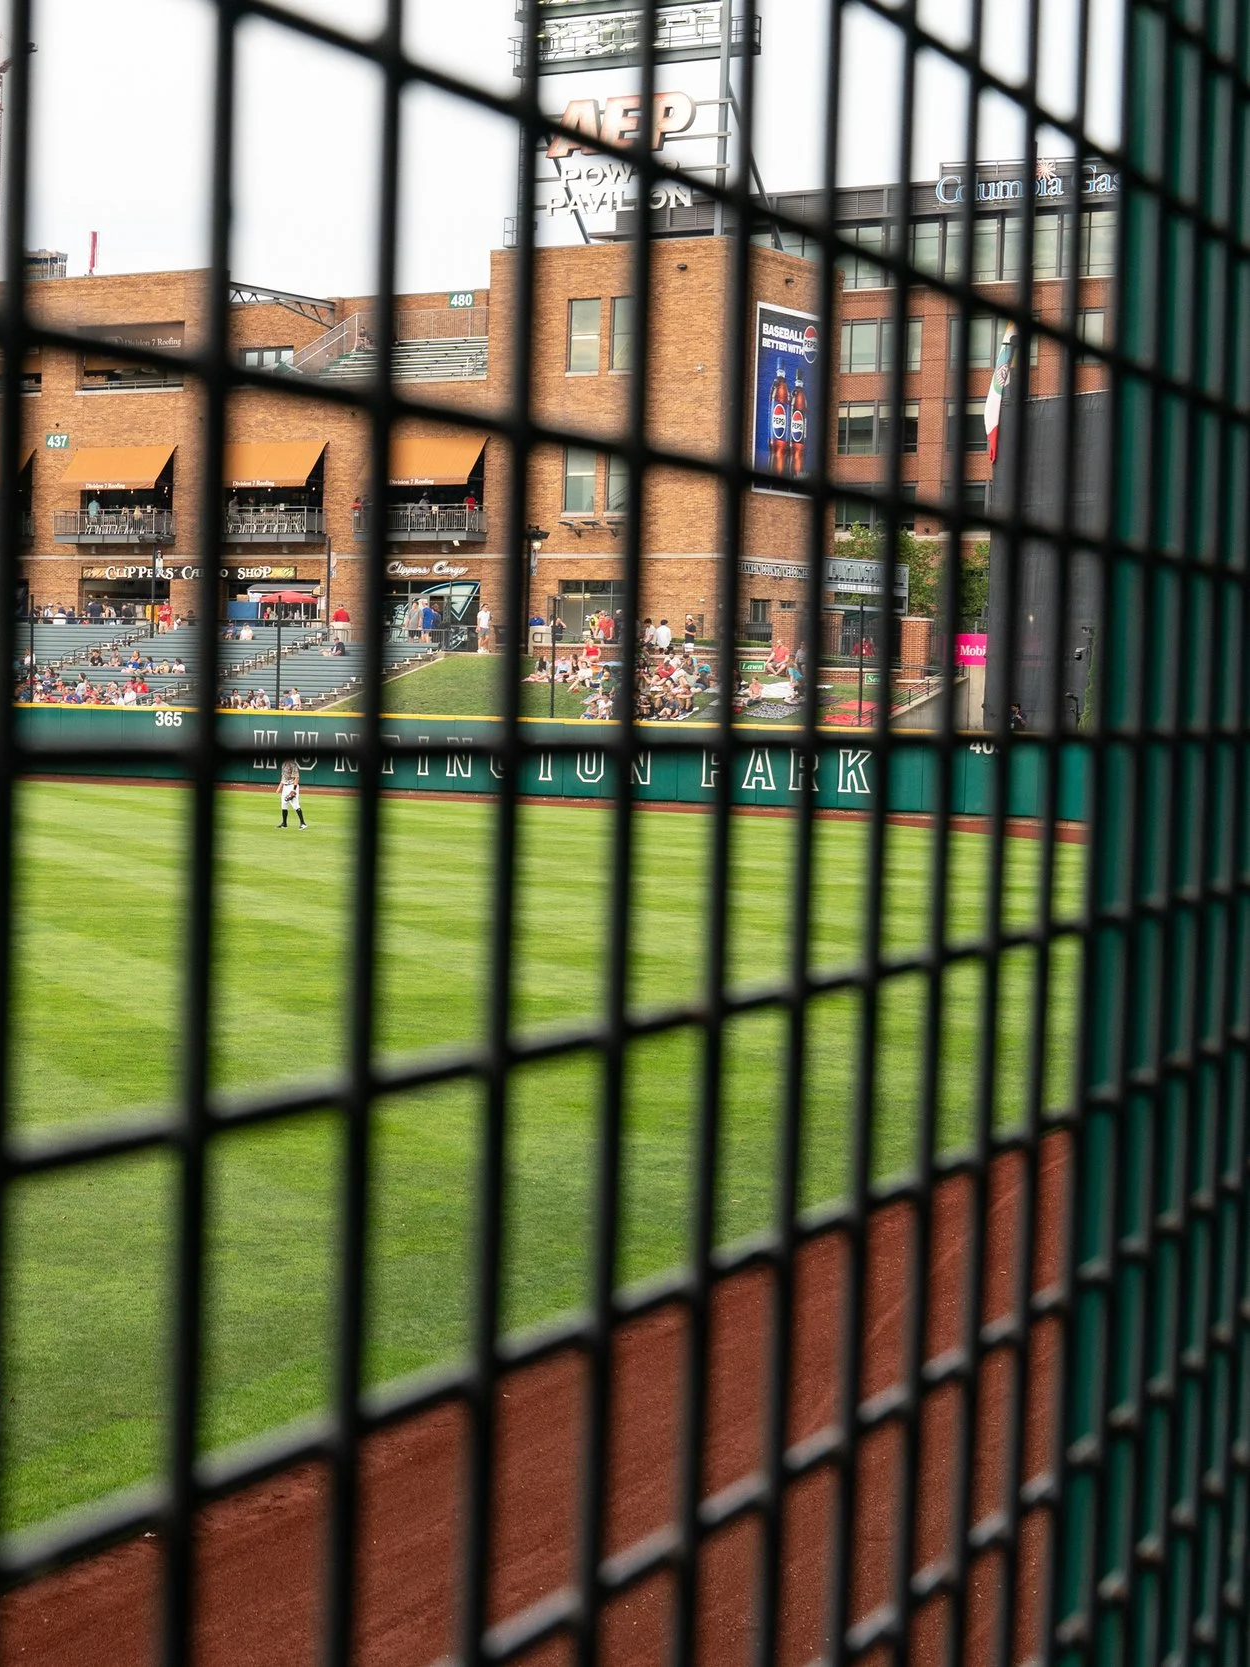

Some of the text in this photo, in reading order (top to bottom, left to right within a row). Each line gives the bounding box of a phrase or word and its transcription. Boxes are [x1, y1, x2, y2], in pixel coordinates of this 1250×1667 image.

[546, 91, 697, 158] AEP
[560, 160, 680, 188] POW
[935, 167, 1065, 204] Coumia
[546, 185, 694, 217] PAVILON
[450, 294, 473, 307] 480
[762, 323, 804, 343] BASEBALL
[157, 337, 181, 347] Roofing
[762, 338, 804, 356] BETTER WITH
[47, 435, 67, 448] 437
[181, 565, 229, 581] CAO
[237, 565, 272, 580] SHOP
[387, 560, 468, 578] Clippers Cargo
[741, 662, 763, 670] Lawn
[155, 711, 183, 727] 365
[969, 742, 999, 755] 40
